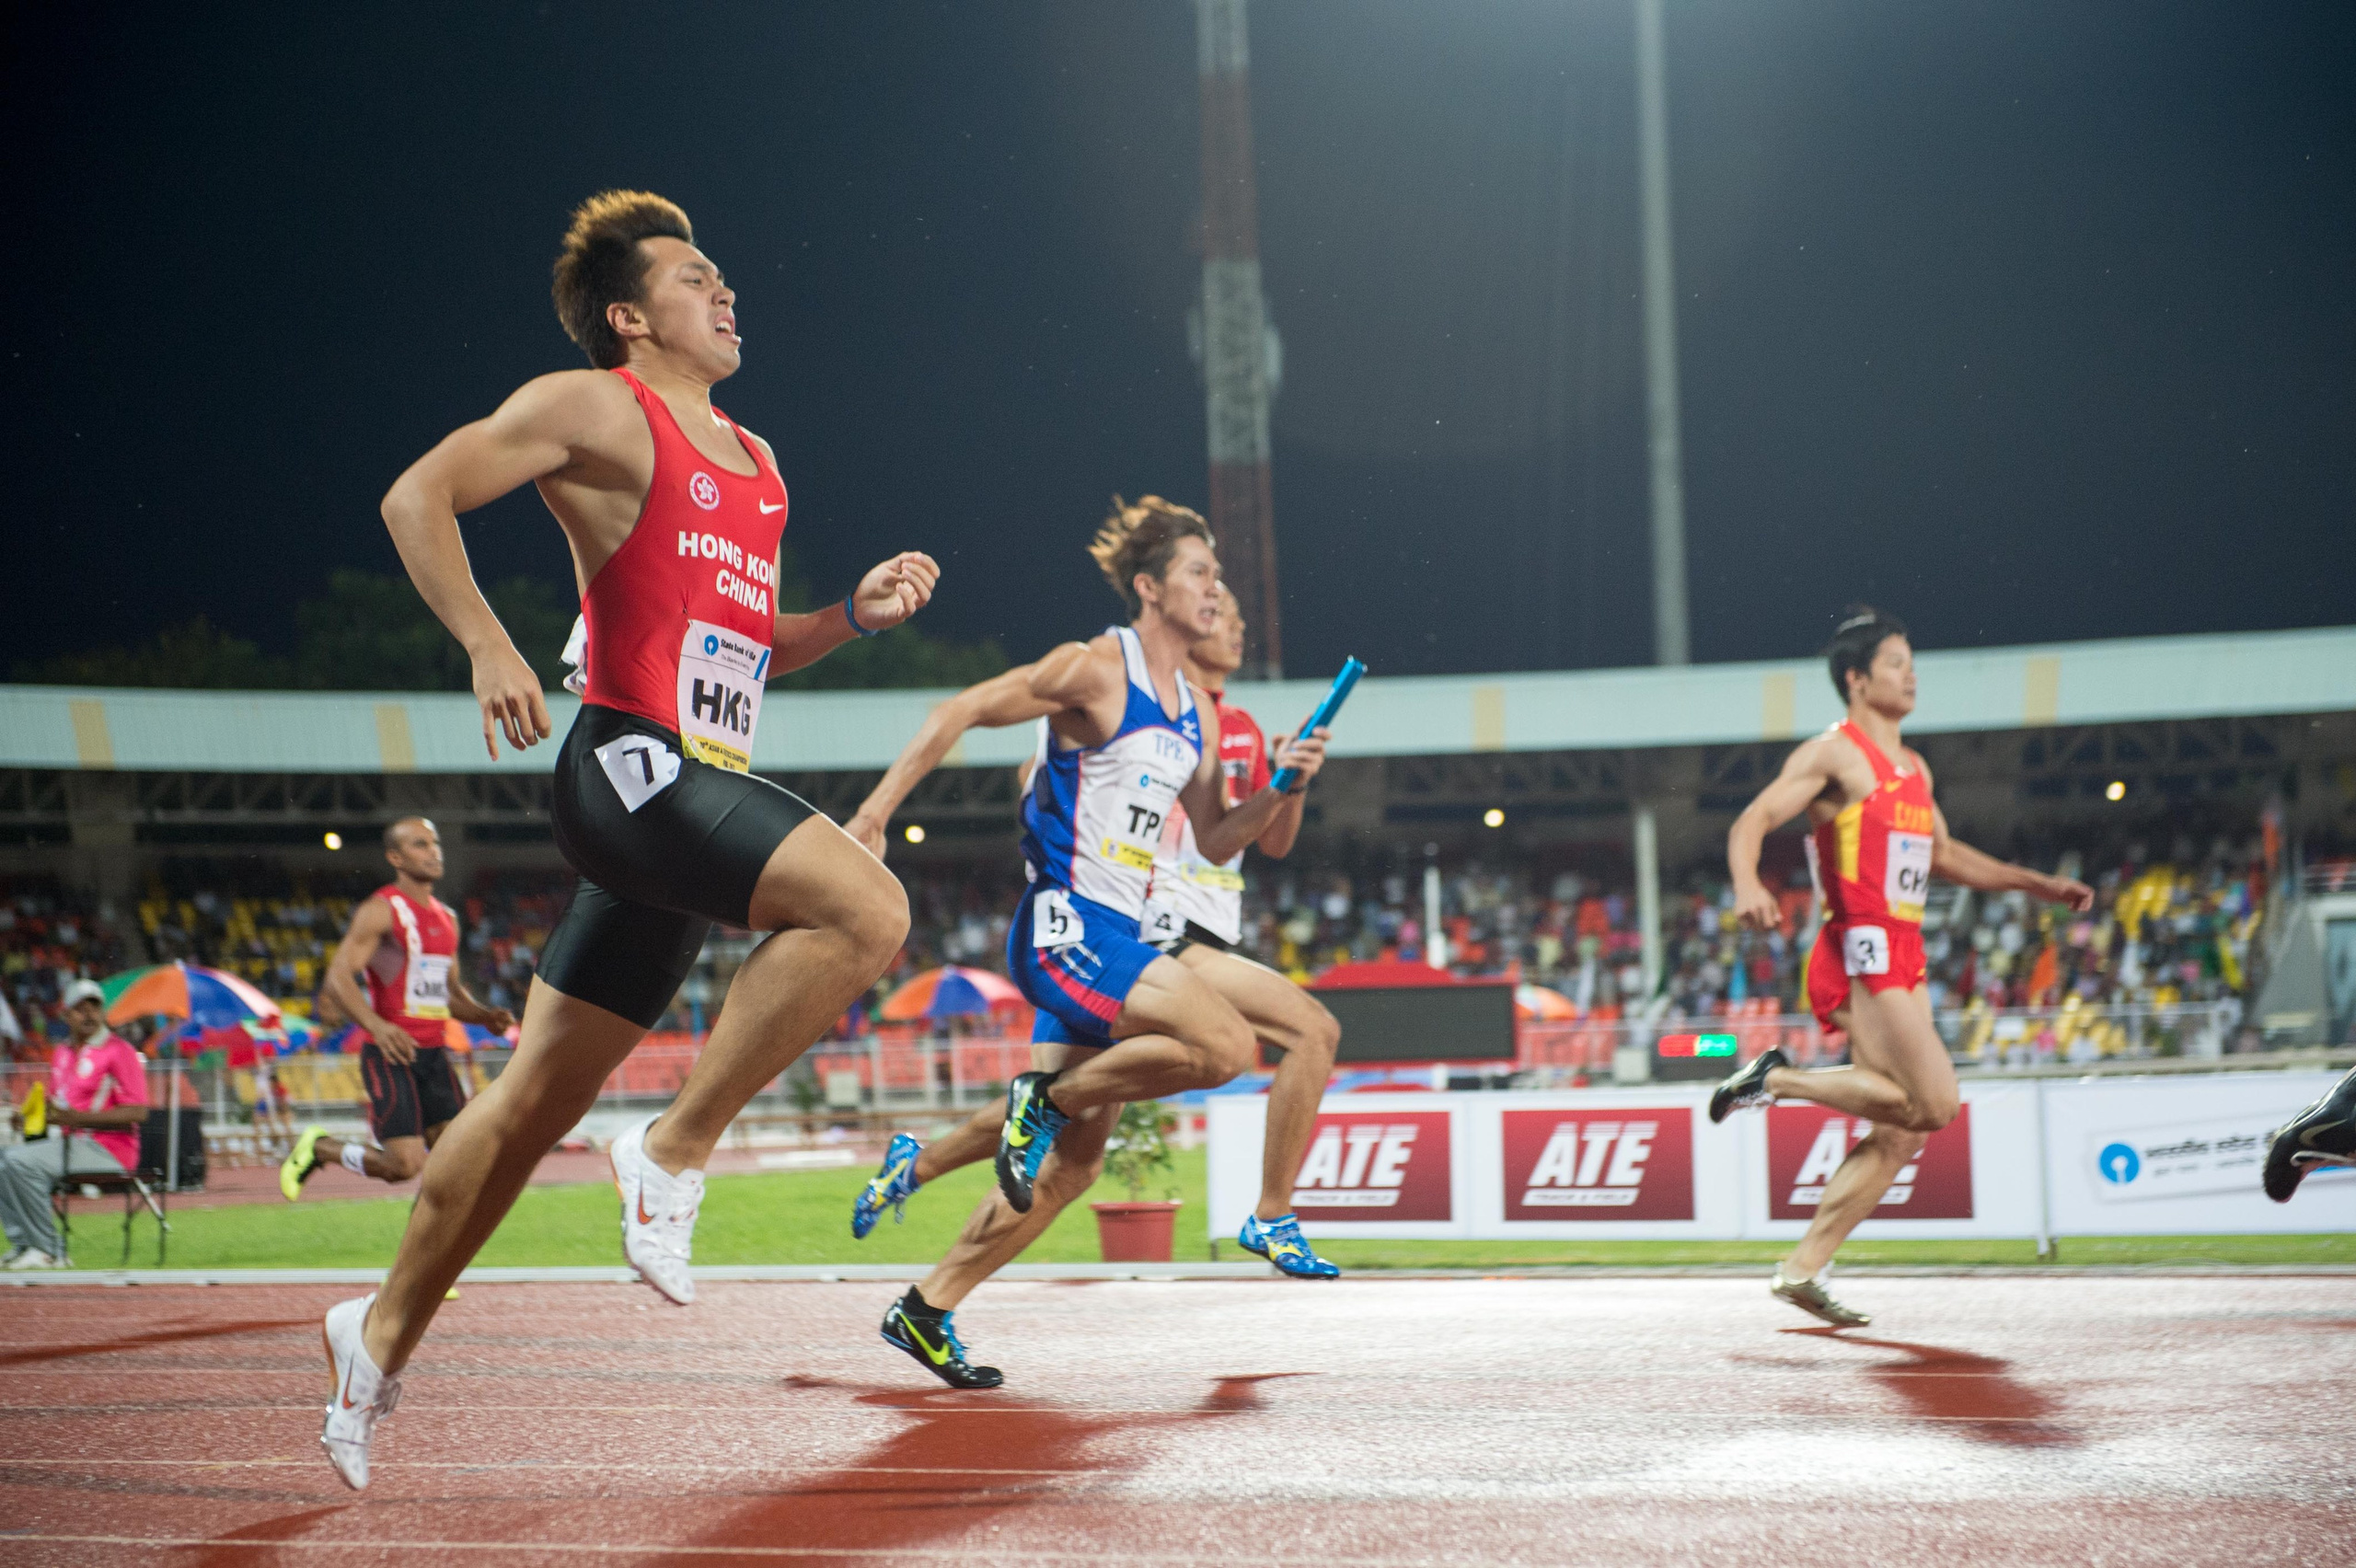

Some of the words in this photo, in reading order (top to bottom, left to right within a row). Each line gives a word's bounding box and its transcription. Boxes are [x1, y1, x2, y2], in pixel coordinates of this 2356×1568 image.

[677, 530, 743, 571] HONG
[716, 569, 768, 617] CHINA
[692, 677, 752, 736] HKG
[621, 746, 655, 787] 7
[1154, 733, 1185, 762] TPE
[1128, 803, 1163, 843] TP
[1049, 904, 1068, 936] 5
[1858, 940, 1876, 967] 3
[1293, 1124, 1420, 1188] ATE
[1527, 1120, 1660, 1187] ATE
